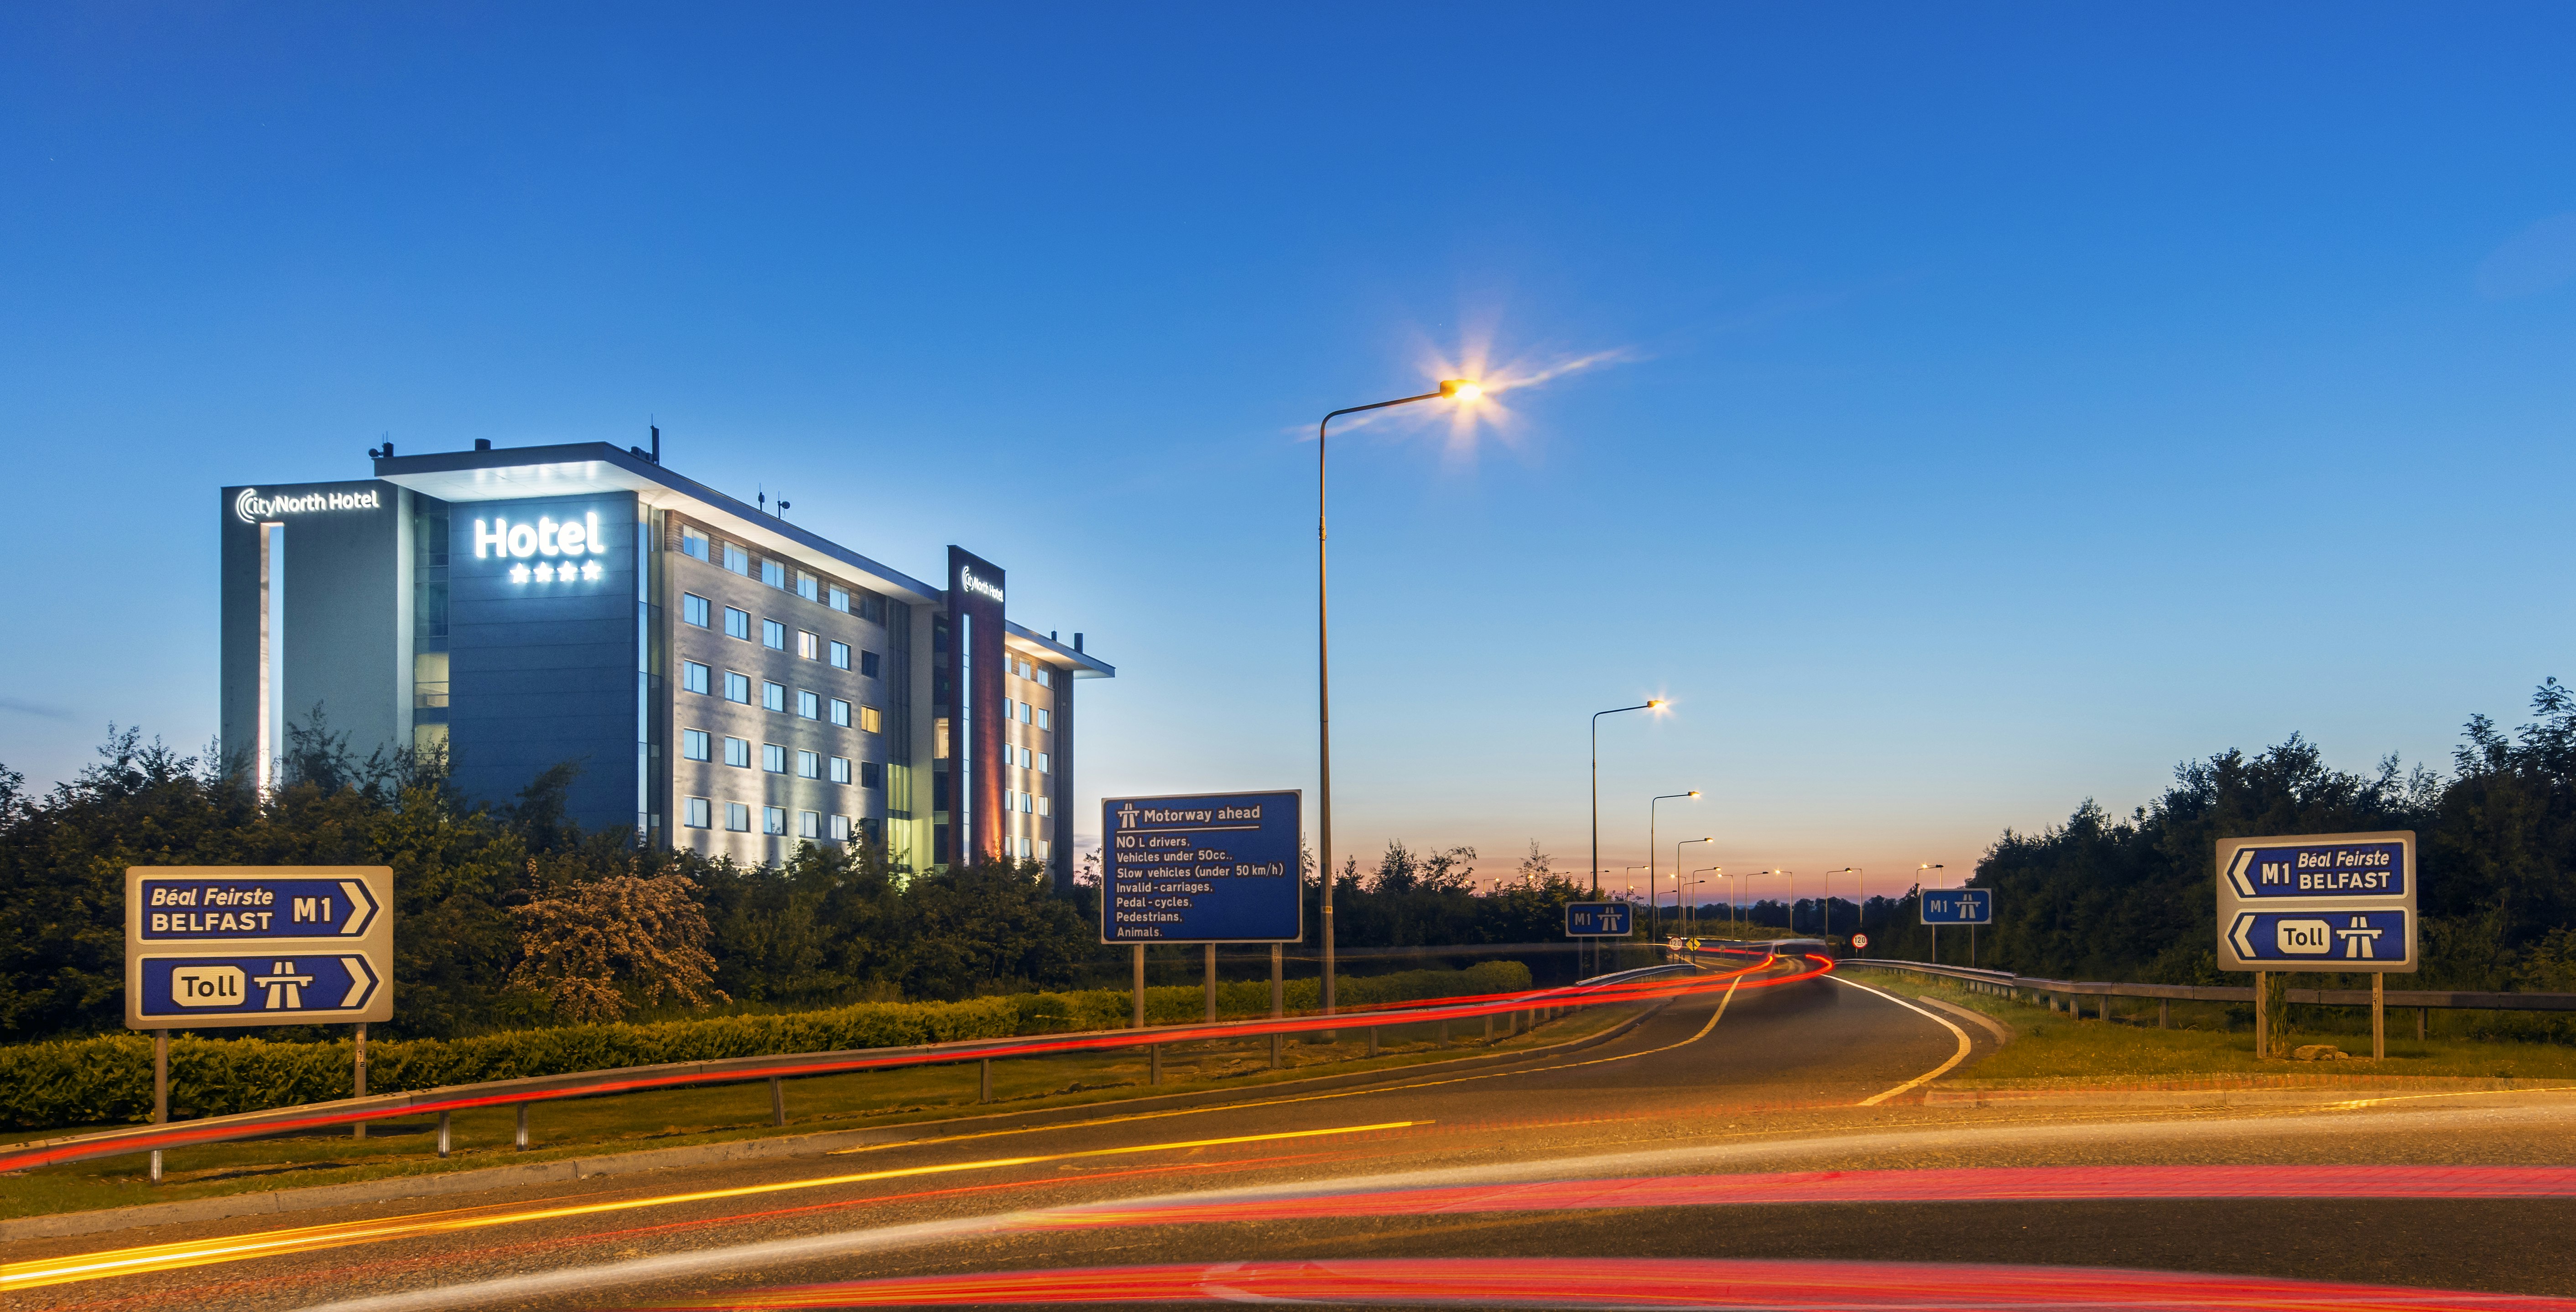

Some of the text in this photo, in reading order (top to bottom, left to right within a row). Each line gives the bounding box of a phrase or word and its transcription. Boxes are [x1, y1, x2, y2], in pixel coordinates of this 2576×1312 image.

[329, 489, 380, 510] Hotel
[475, 512, 604, 558] Hotel
[989, 584, 1004, 603] Hotel
[1145, 805, 1260, 823] Motorway ahead
[1117, 836, 1135, 848] NO
[1139, 838, 1145, 847] L
[1117, 852, 1160, 863] Vehicles
[1164, 851, 1194, 861] under
[2298, 850, 2389, 868] Béal Feirste
[1117, 863, 1283, 878] Slow vehicles (under 50 km/h)
[2262, 863, 2289, 884] M1
[2300, 872, 2390, 889] BELFAST
[151, 888, 273, 906] Béal Feirste
[294, 898, 330, 922] M1
[1931, 900, 1947, 913] M1
[152, 912, 272, 931] BELFAST
[1575, 913, 1590, 925] M1
[2283, 927, 2323, 946] Toll
[181, 975, 237, 997] Toll
